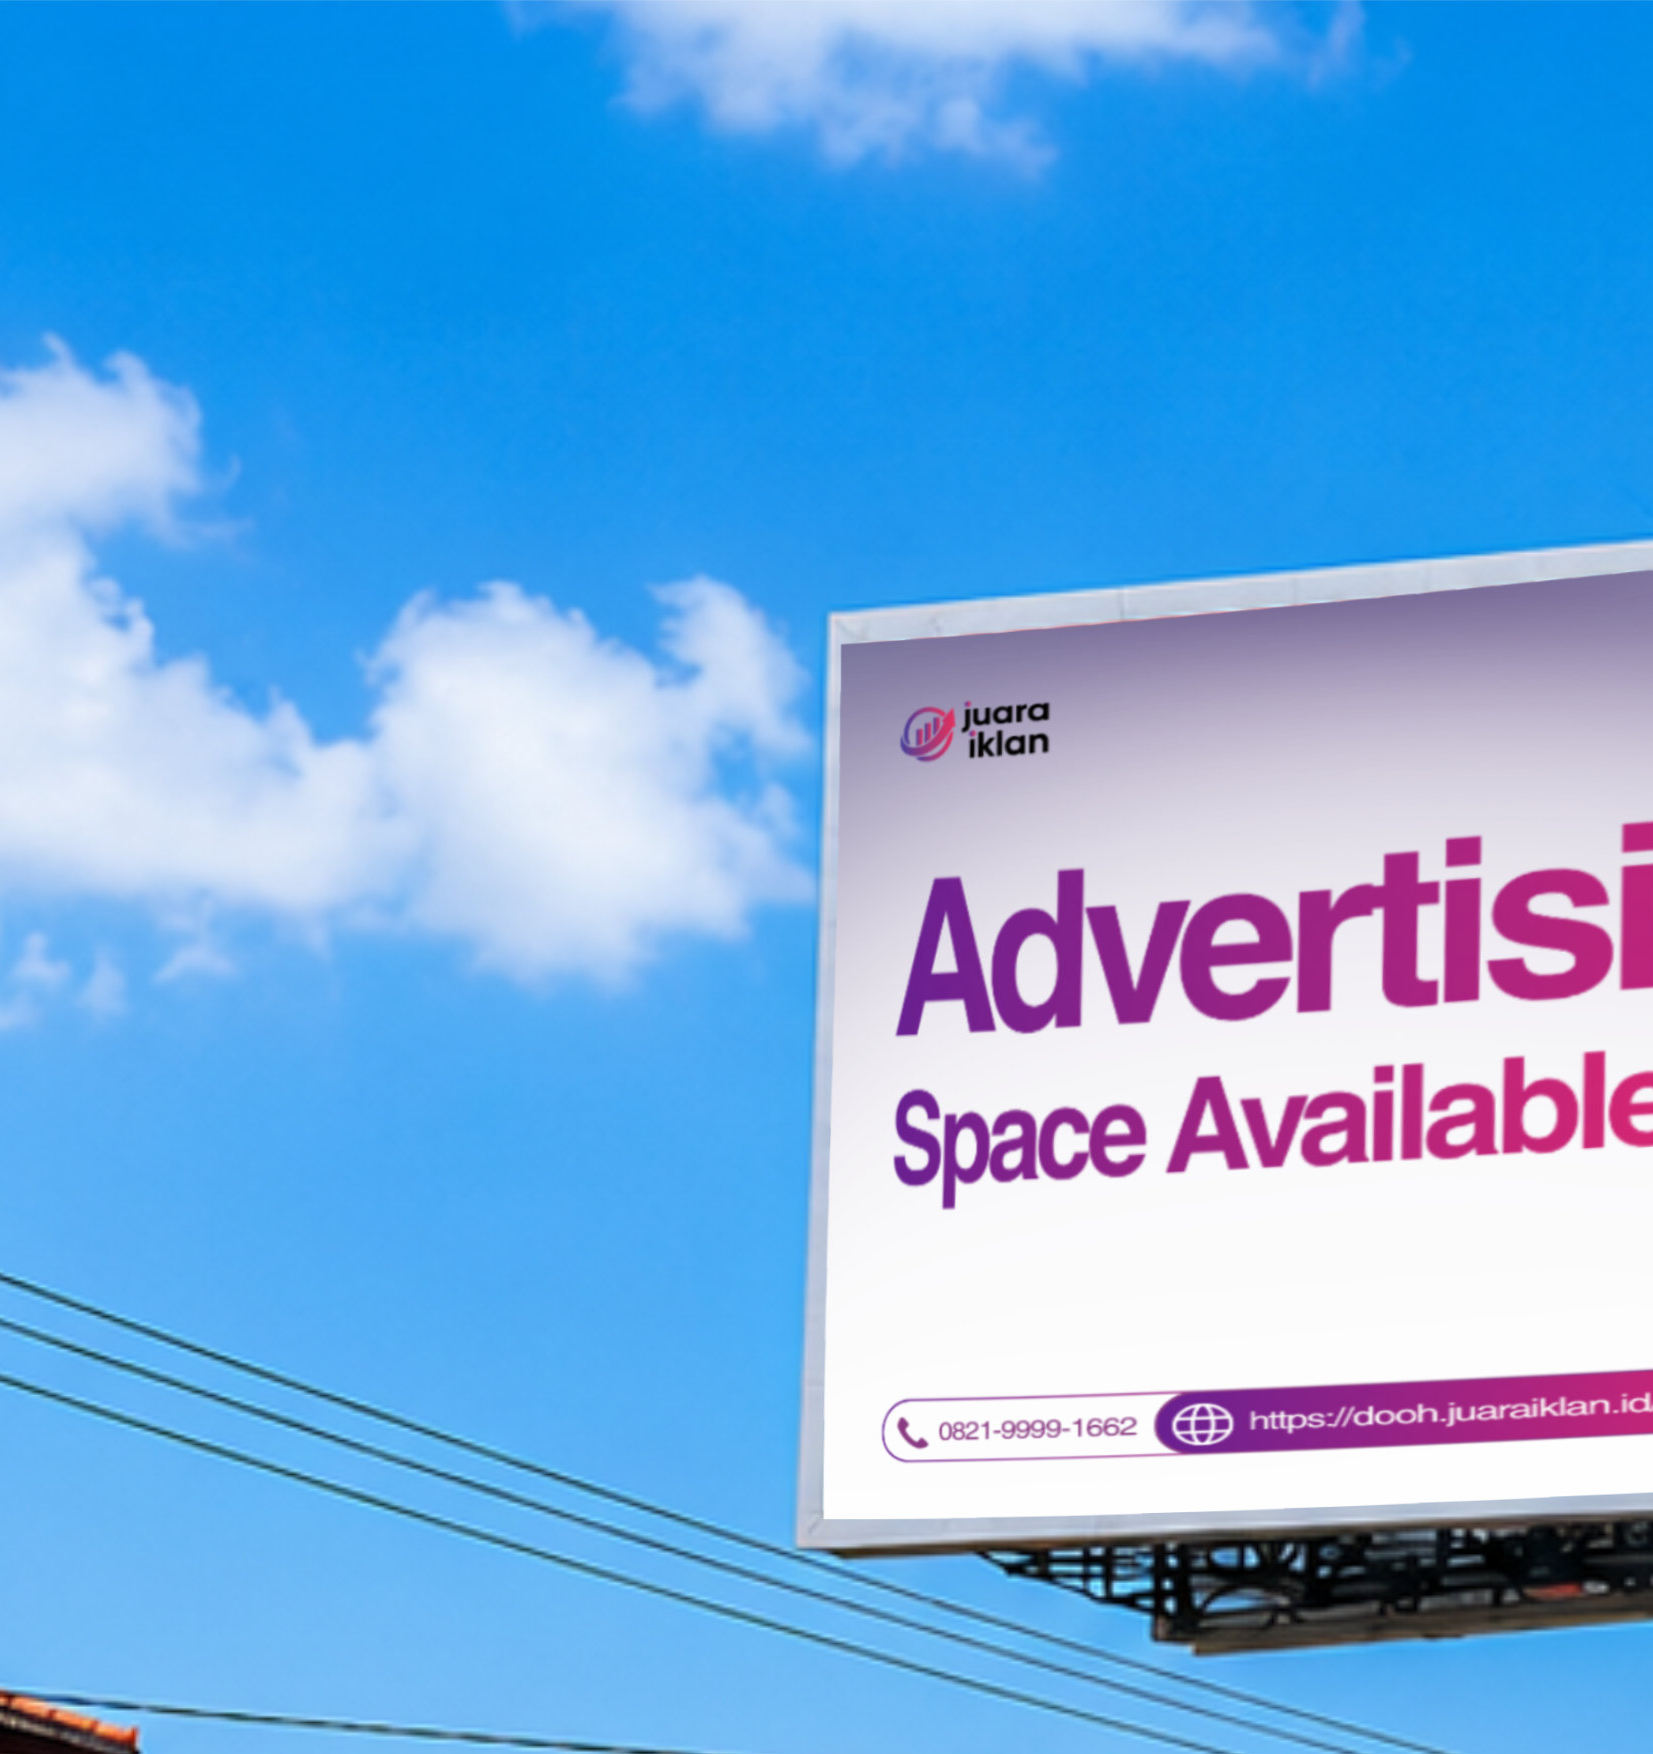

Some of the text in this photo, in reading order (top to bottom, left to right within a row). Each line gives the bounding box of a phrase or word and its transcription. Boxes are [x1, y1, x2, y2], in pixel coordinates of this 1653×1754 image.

[961, 700, 1050, 734] juara
[968, 729, 1050, 759] iklan
[893, 1088, 1147, 1210] Space
[938, 1415, 1138, 1442] 0821-9999-1662
